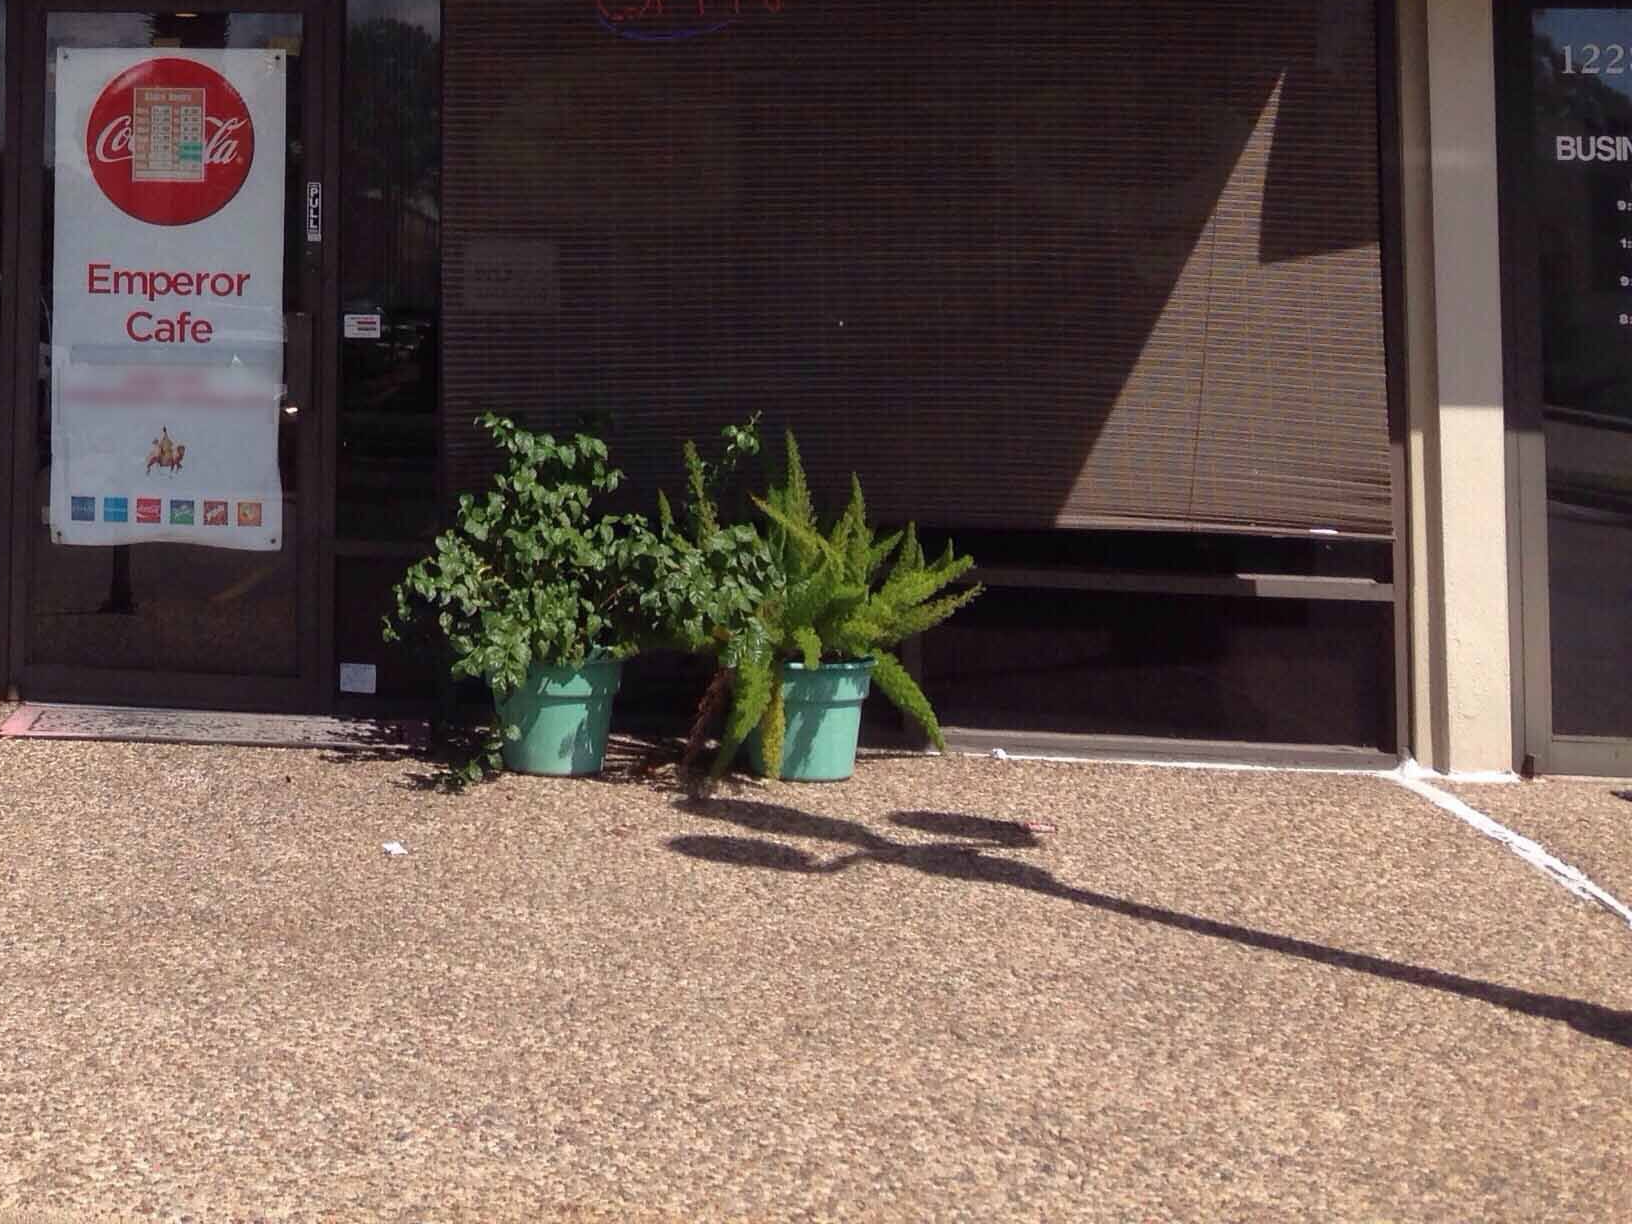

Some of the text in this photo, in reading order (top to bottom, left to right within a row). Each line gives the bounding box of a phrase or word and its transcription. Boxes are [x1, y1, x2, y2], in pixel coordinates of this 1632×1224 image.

[1561, 43, 1632, 74] 122
[309, 187, 319, 229] PULL
[88, 263, 251, 302] Emperor
[126, 311, 214, 344] Cafe
